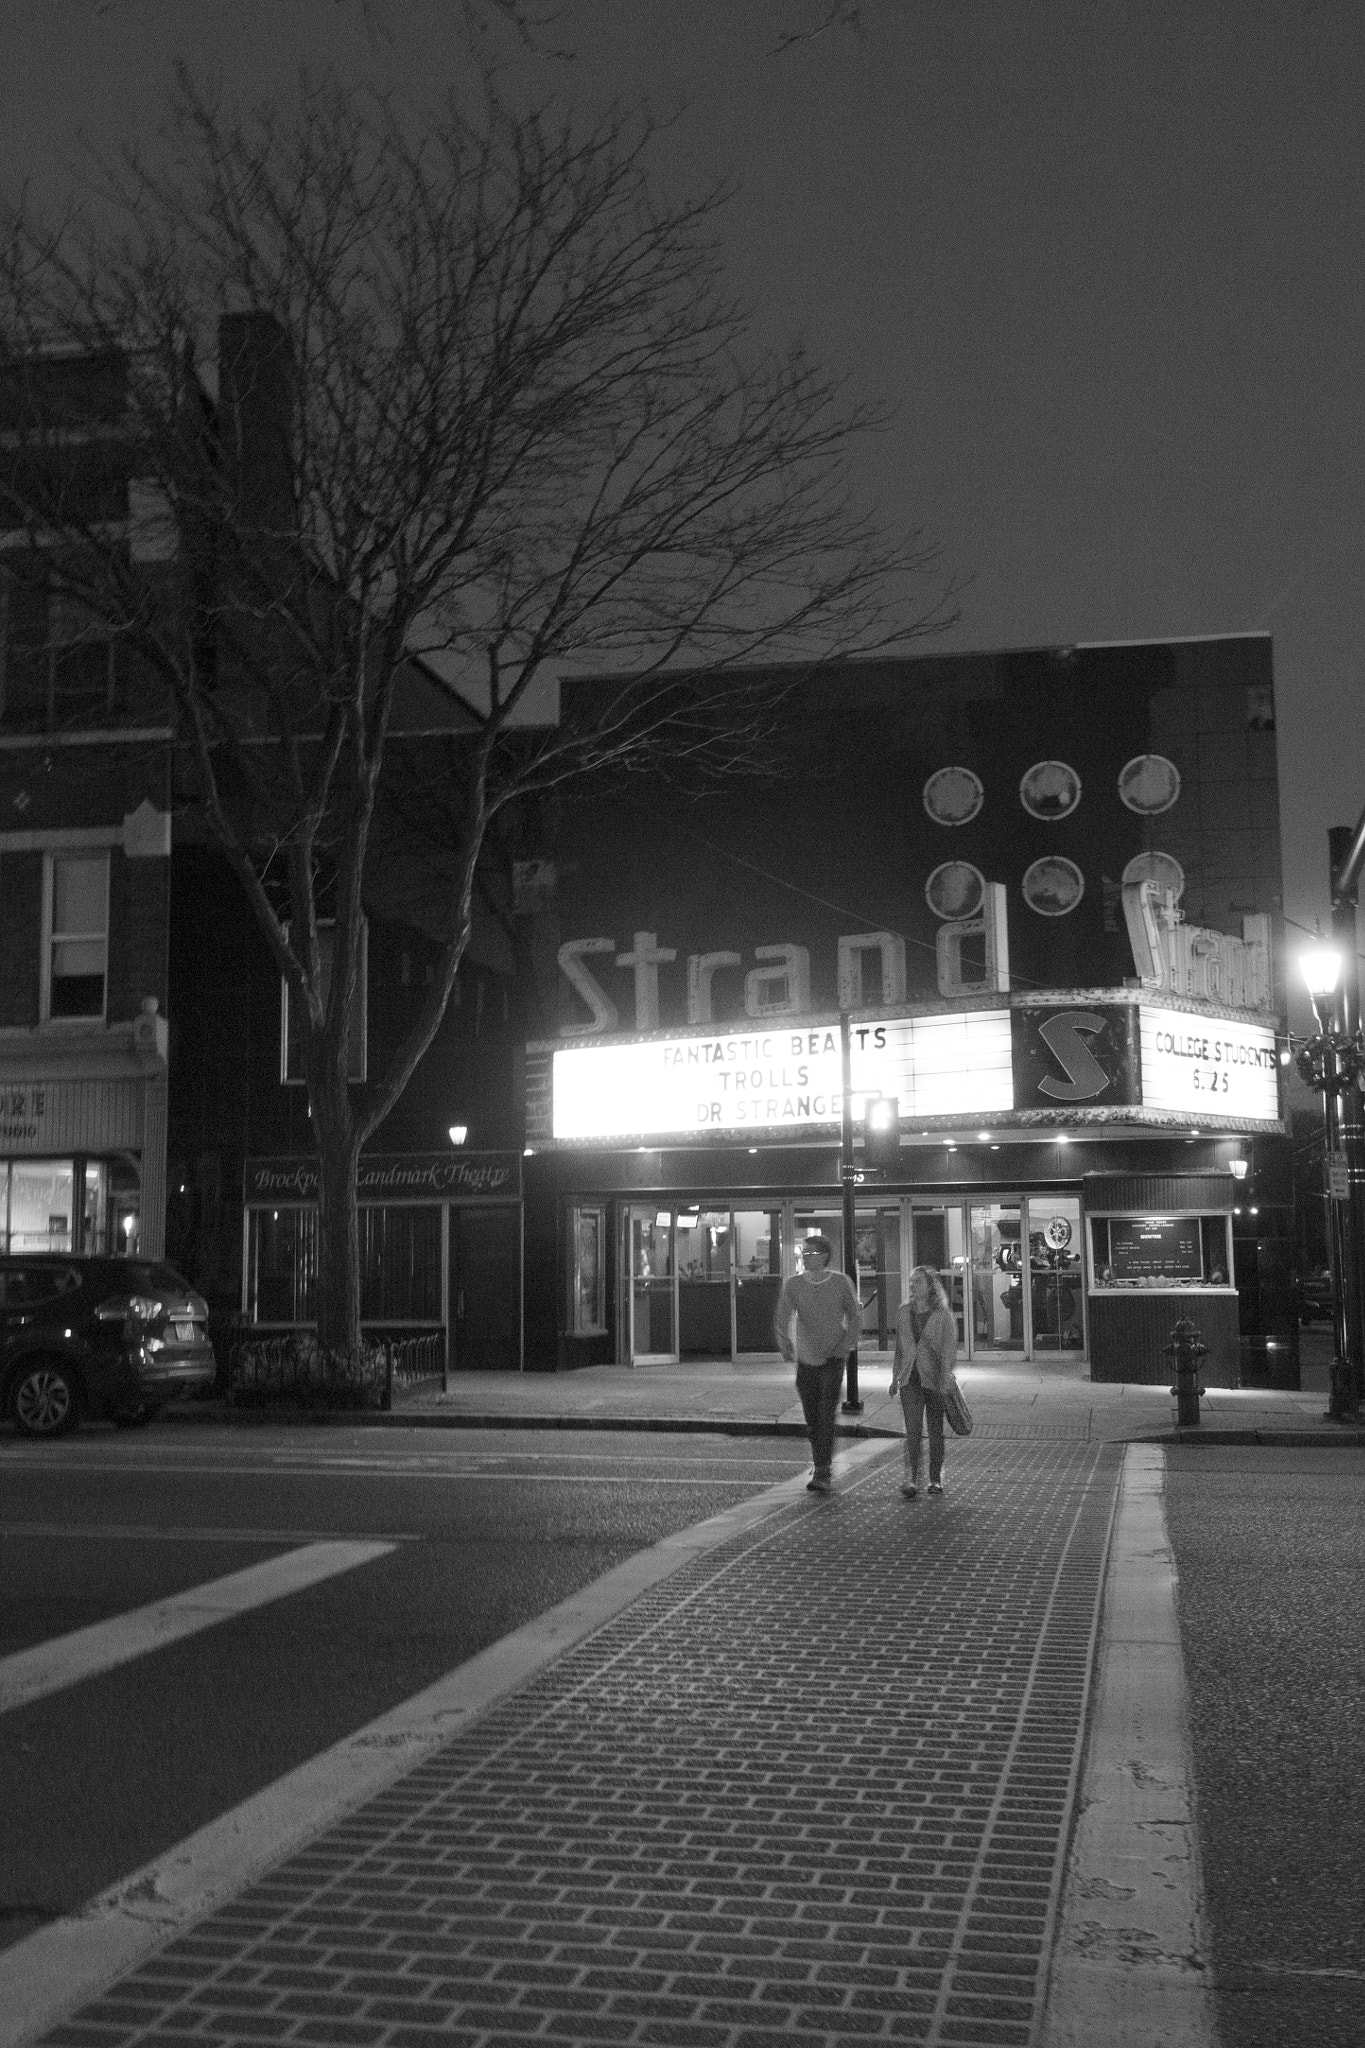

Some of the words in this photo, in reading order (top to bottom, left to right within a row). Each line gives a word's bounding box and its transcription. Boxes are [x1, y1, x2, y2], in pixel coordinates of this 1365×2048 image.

[557, 881, 1009, 1037] Strand
[663, 1038, 773, 1067] FANTASTIC
[790, 1027, 887, 1056] BEATS
[1038, 1010, 1111, 1101] S
[1155, 1031, 1210, 1061] COLLEGE
[1214, 1040, 1278, 1070] STUDENTS
[719, 1065, 810, 1092] TROLLS
[0, 1091, 46, 1117] RE
[697, 1101, 722, 1123] DR
[736, 1094, 842, 1121] STRANGE
